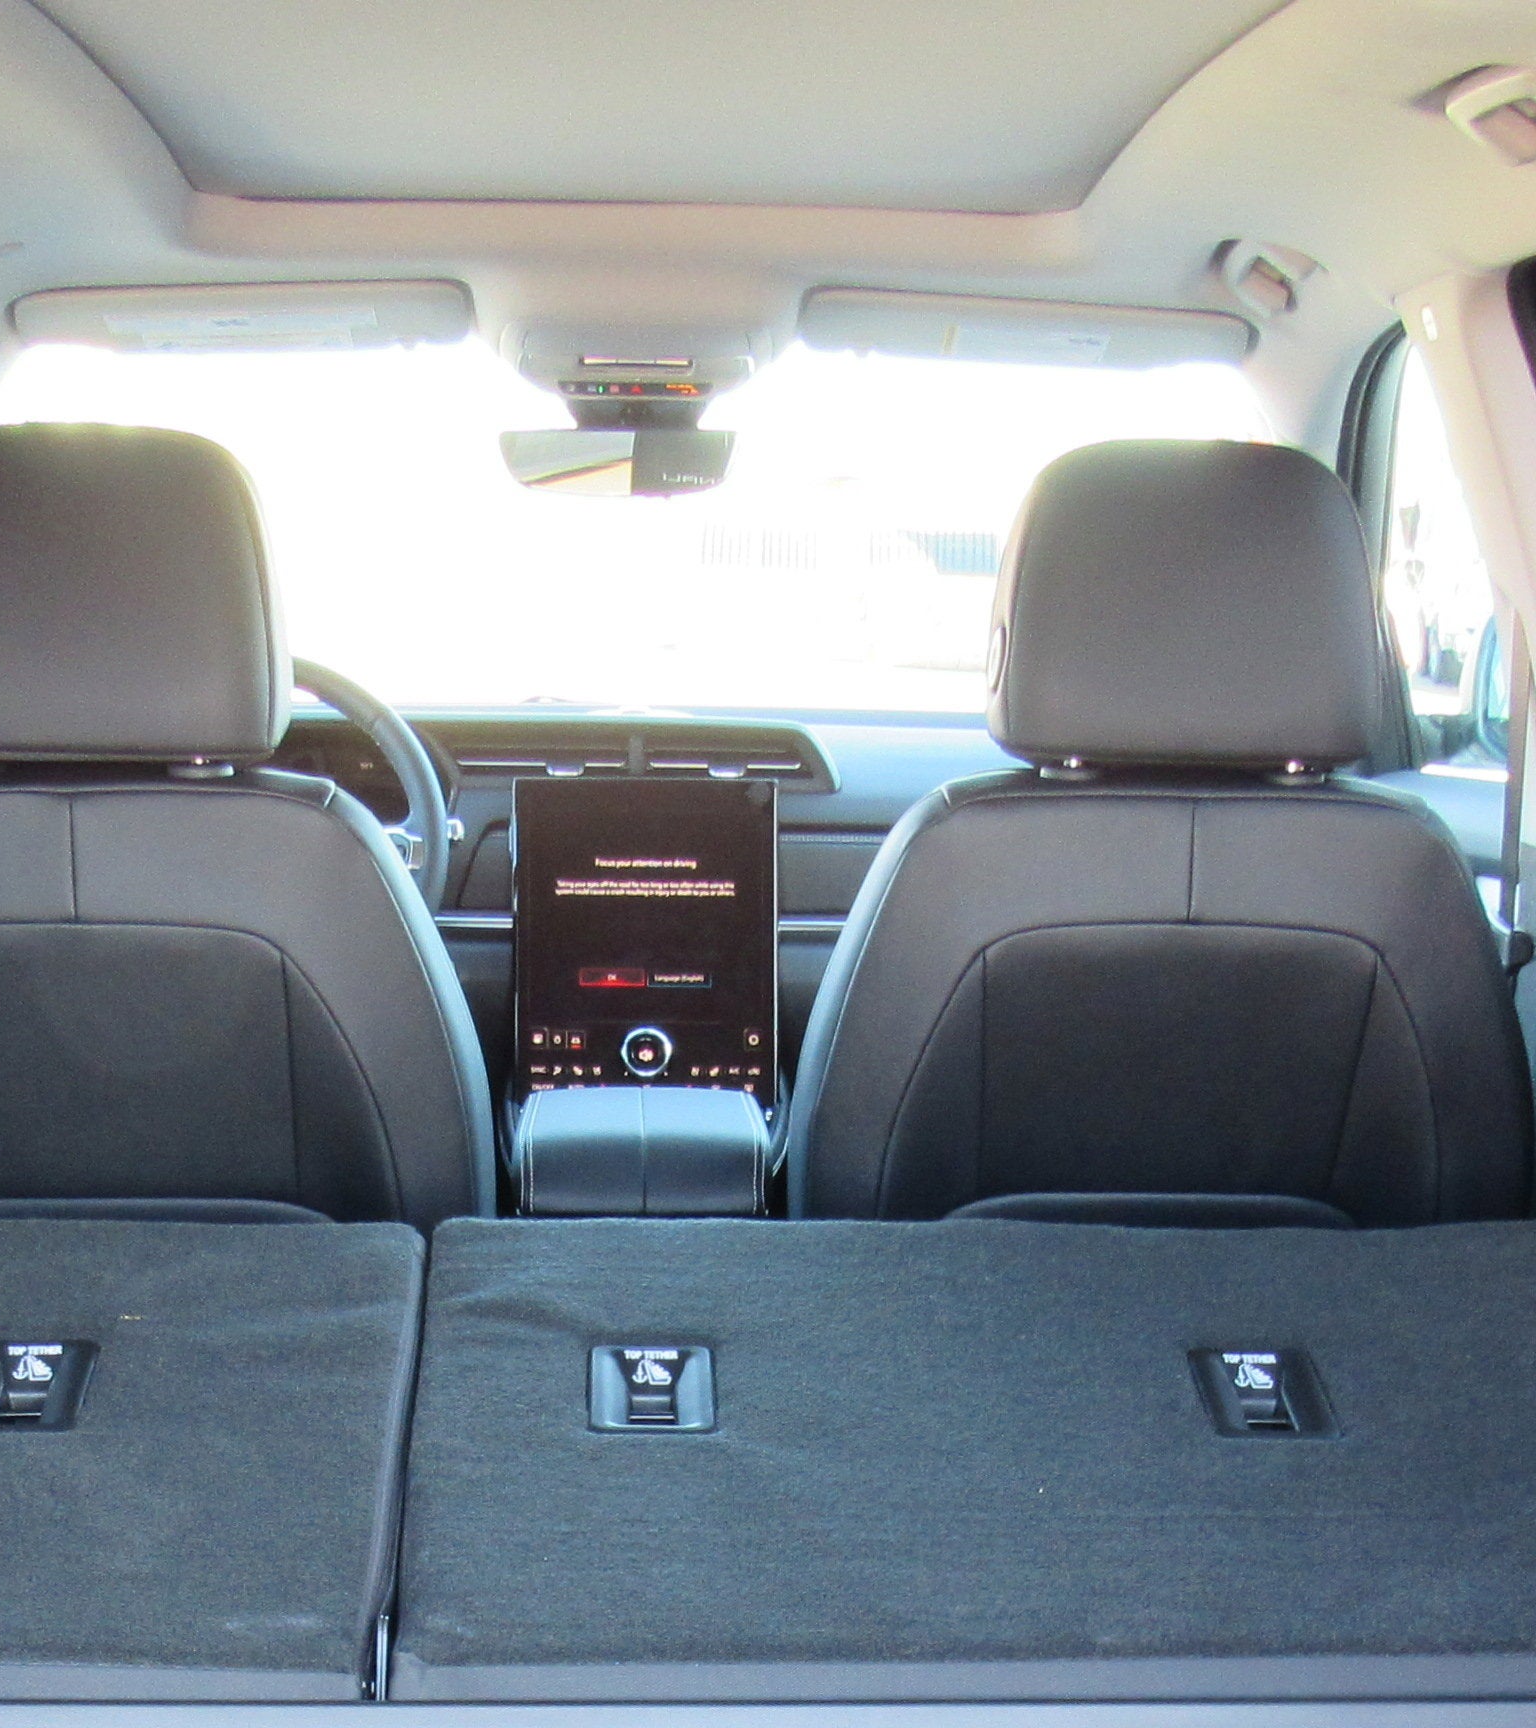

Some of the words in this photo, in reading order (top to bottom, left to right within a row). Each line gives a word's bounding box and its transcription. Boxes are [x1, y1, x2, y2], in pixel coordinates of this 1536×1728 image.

[595, 858, 615, 869] Focus
[616, 858, 631, 869] your
[632, 858, 662, 869] attention
[663, 858, 672, 869] on
[673, 858, 697, 869] driving
[7, 1345, 27, 1355] TOP
[27, 1344, 63, 1355] TETHER
[624, 1349, 643, 1360] TOP
[643, 1349, 678, 1360] TETHER
[1222, 1353, 1241, 1363] TOP
[1241, 1353, 1277, 1364] TETHER
